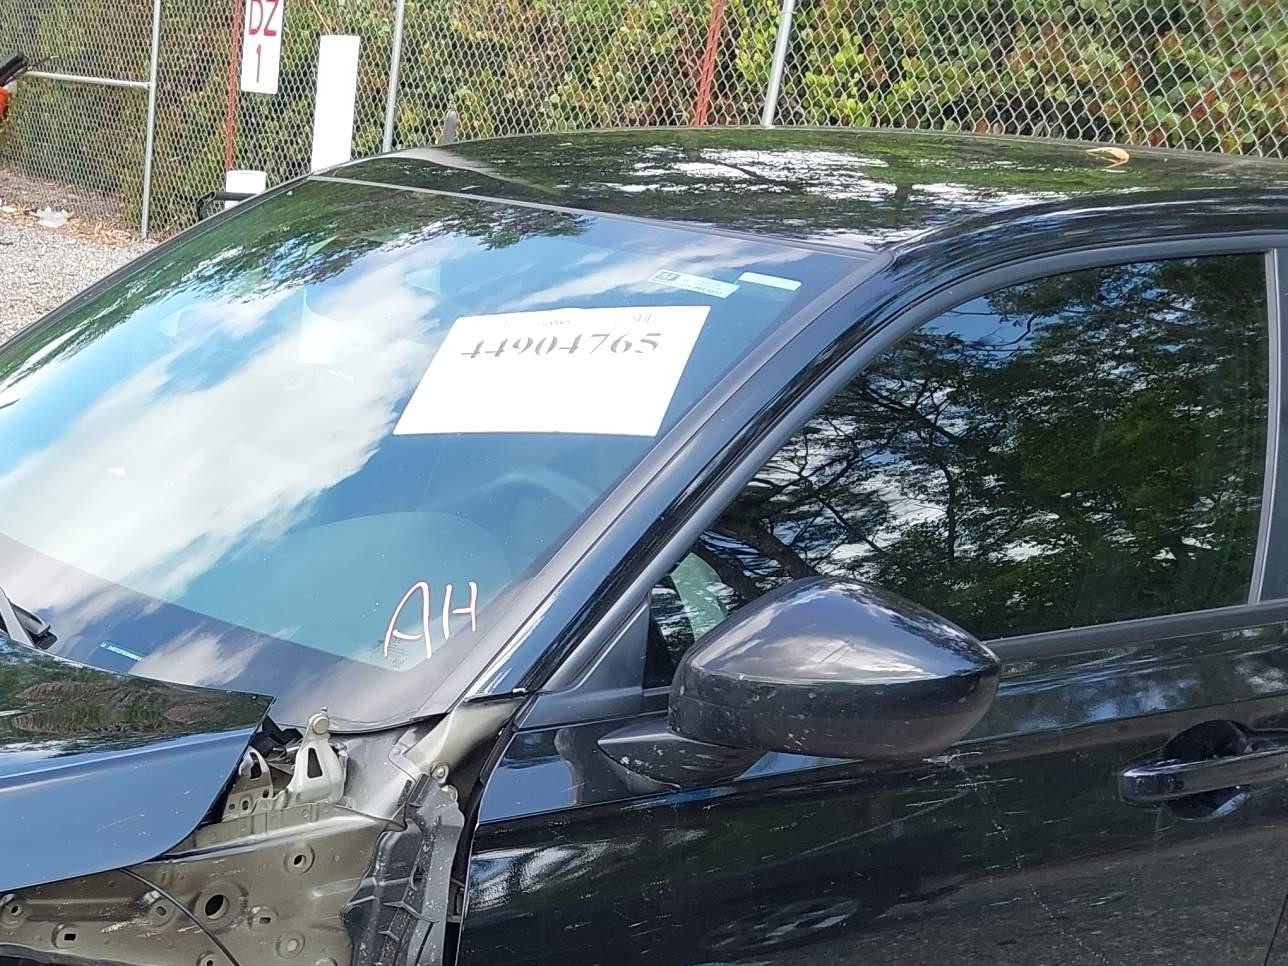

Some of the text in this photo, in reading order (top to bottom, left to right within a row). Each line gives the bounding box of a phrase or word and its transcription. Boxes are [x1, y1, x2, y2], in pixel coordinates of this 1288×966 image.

[249, 0, 279, 36] DZ
[256, 44, 262, 83] 1
[461, 332, 662, 359] 44904765
[384, 581, 478, 660] AH
